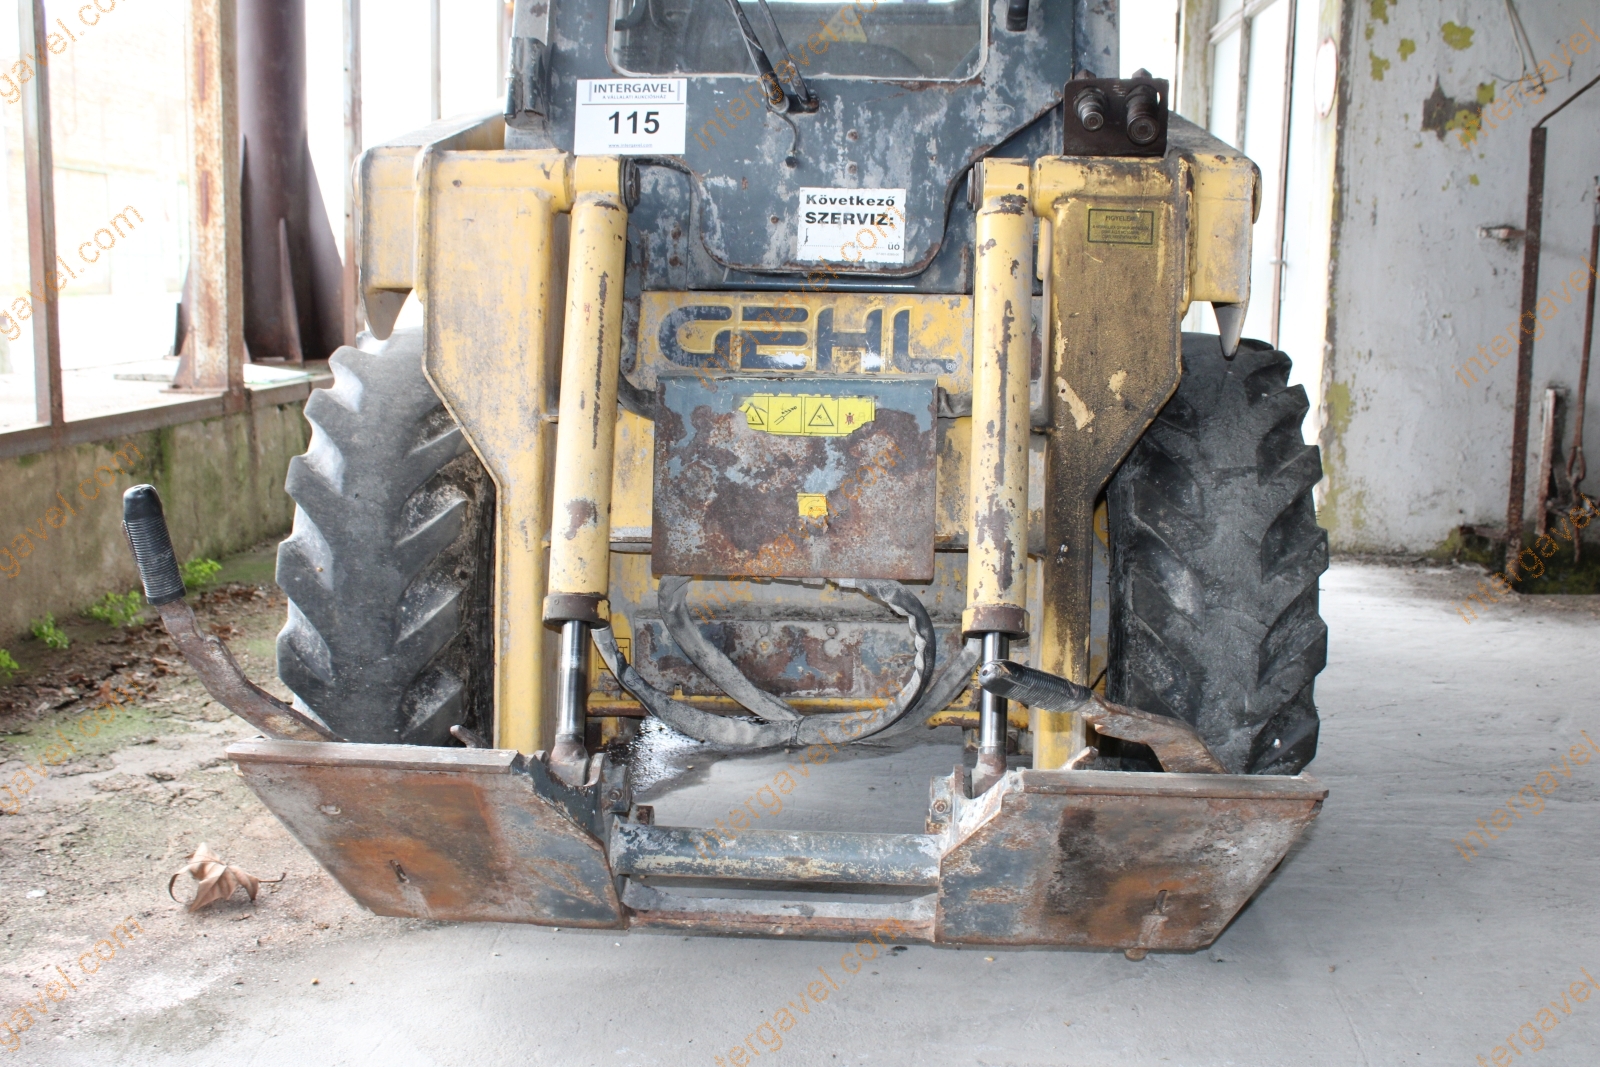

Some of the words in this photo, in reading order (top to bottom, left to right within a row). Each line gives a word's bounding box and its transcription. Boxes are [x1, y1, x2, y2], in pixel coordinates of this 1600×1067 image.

[594, 83, 675, 94] INTERGAVEL
[608, 111, 660, 134] 115
[806, 194, 895, 206] Következő
[805, 211, 894, 226] SZERVIZ:
[656, 303, 957, 374] GEHL
